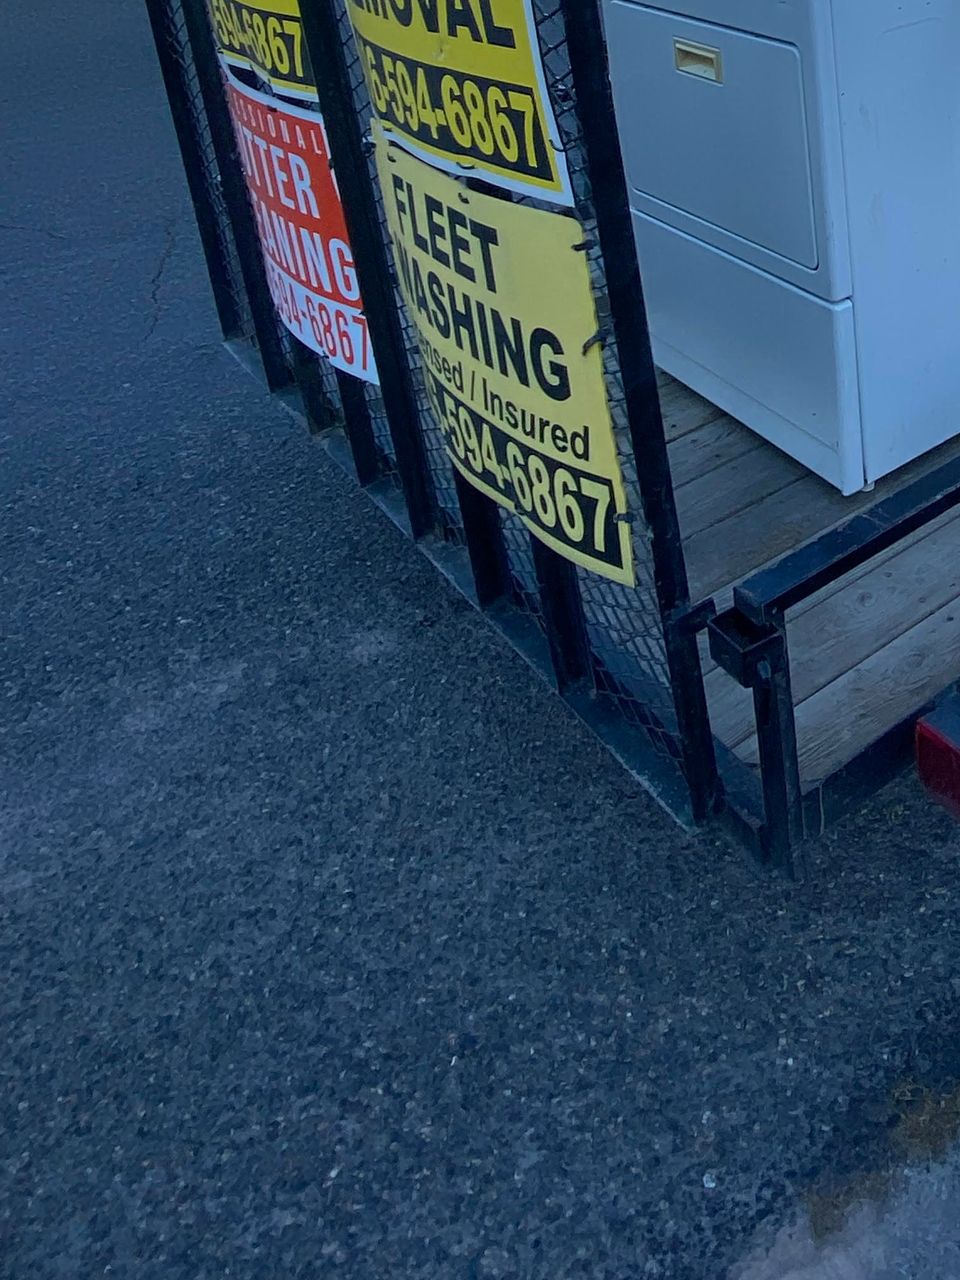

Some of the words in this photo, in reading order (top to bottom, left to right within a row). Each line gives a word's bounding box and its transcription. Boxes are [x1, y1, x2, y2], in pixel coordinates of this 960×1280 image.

[366, 45, 537, 168] 6-594-6867
[392, 173, 499, 294] FLEET
[394, 232, 571, 402] WASHING
[482, 377, 590, 461] Insured
